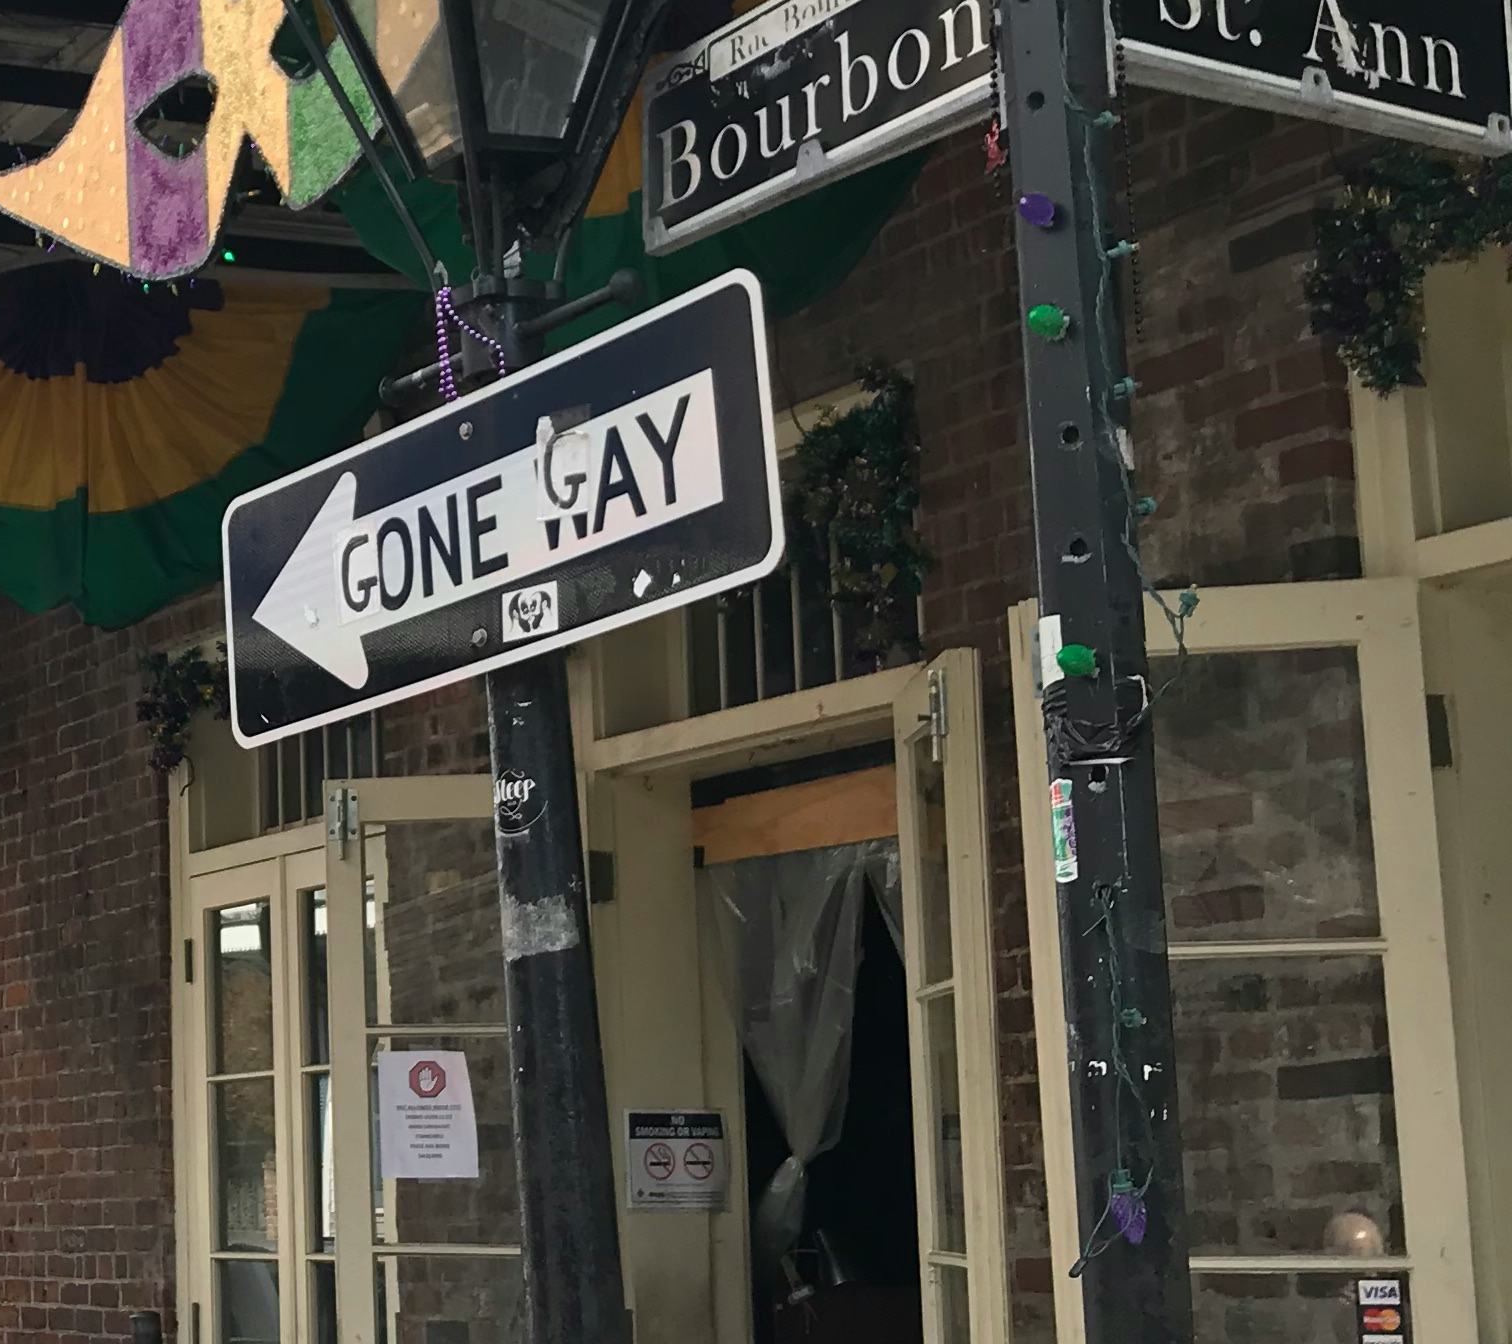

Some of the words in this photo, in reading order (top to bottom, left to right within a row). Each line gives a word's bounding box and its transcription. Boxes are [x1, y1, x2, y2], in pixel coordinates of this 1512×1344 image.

[341, 474, 509, 612] GONE
[543, 393, 691, 535] GAY
[670, 1116, 685, 1125] NO
[635, 1126, 675, 1136] SMOKING
[1363, 1286, 1398, 1299] VISA
